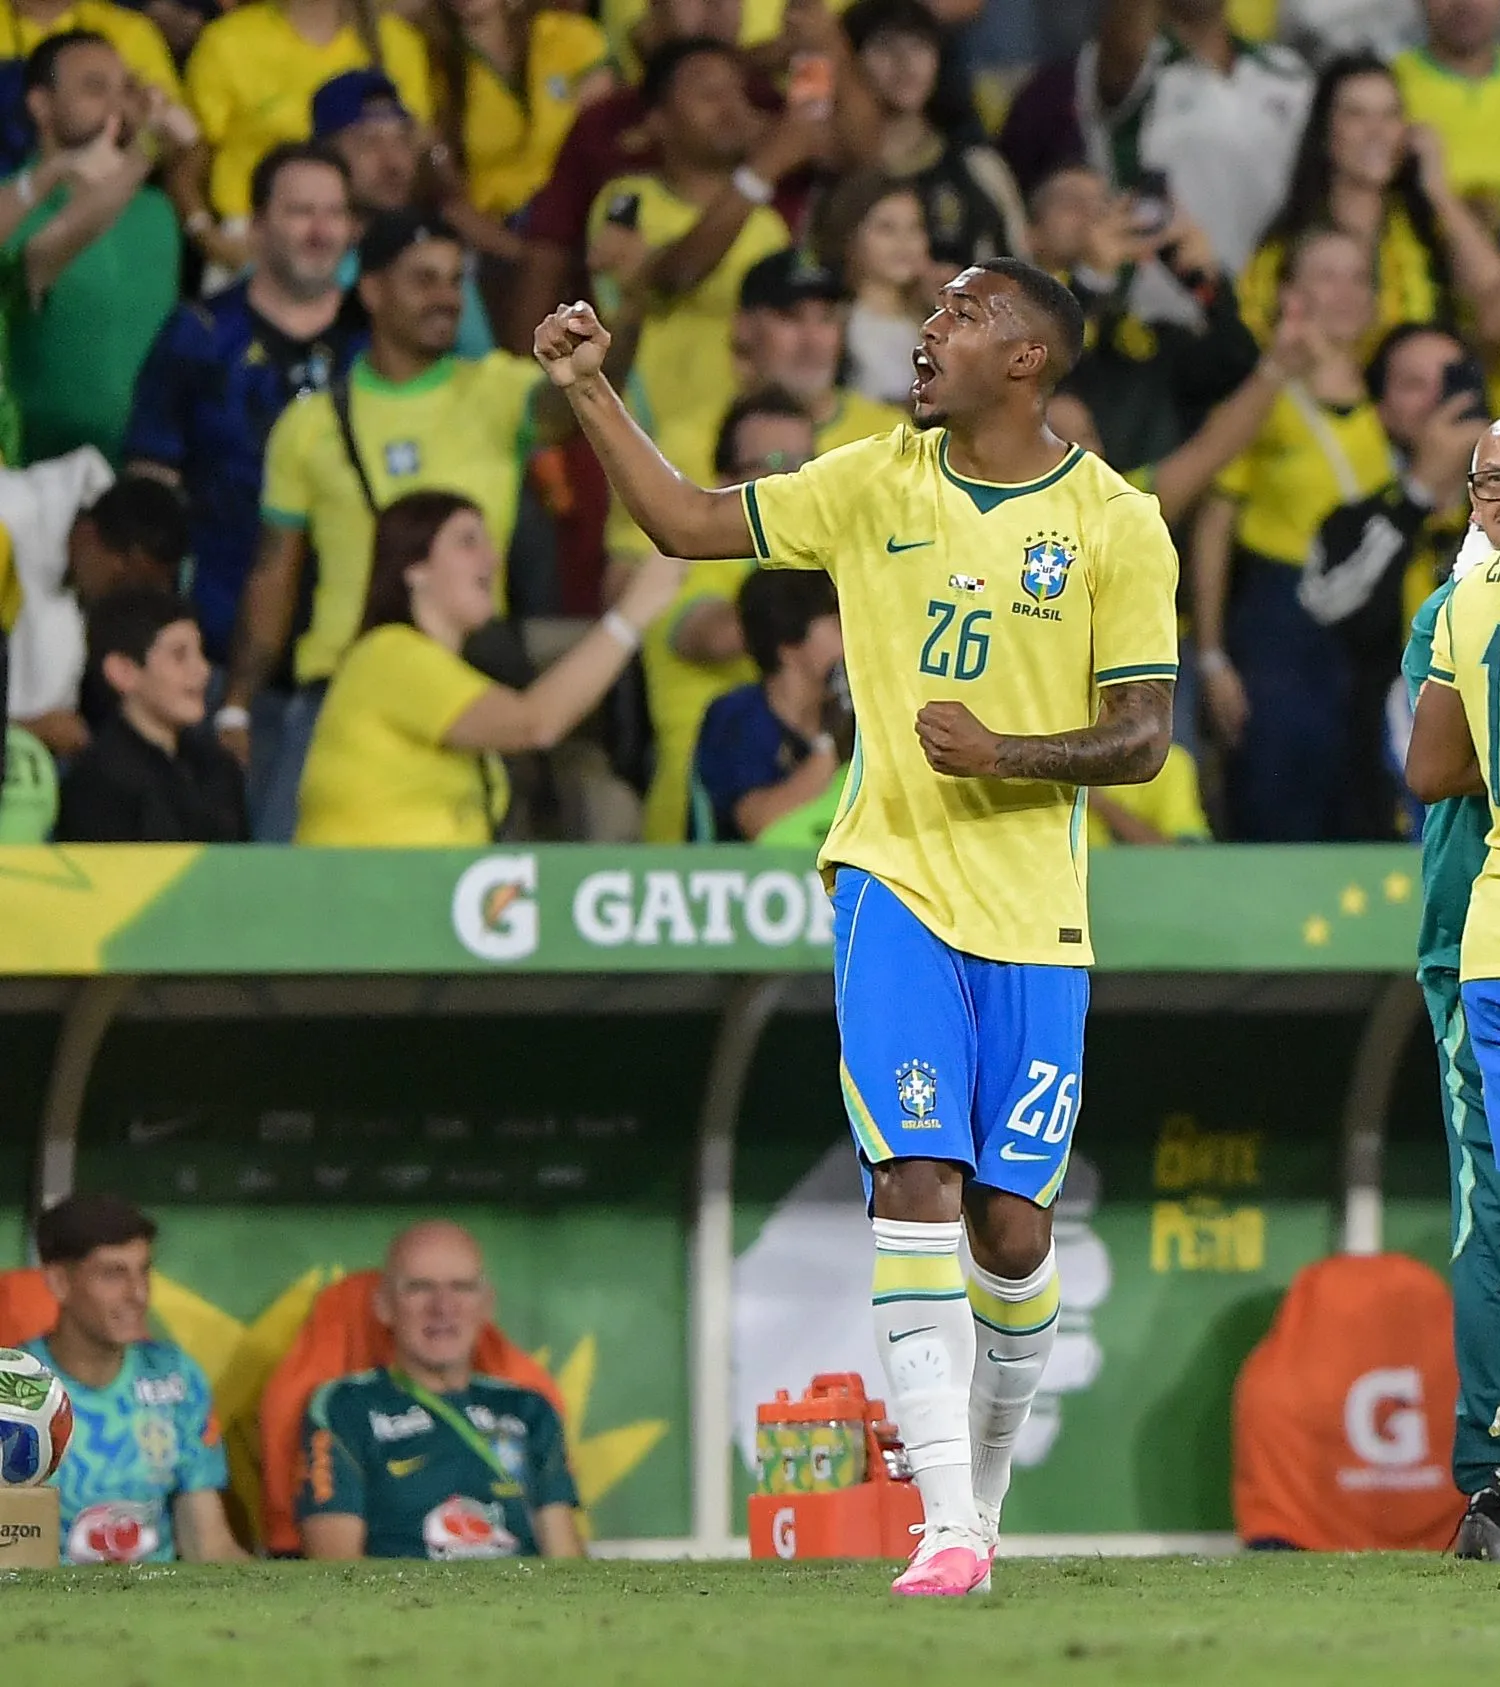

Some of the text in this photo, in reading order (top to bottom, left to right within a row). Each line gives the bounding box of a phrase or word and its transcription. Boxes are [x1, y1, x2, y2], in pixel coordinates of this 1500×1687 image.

[919, 600, 993, 681] 26
[1011, 602, 1063, 622] BRASIL
[453, 853, 539, 961] G
[902, 1119, 942, 1129] BRASIL
[1006, 1059, 1076, 1144] 26
[1344, 1366, 1429, 1464] G
[773, 1507, 796, 1560] G
